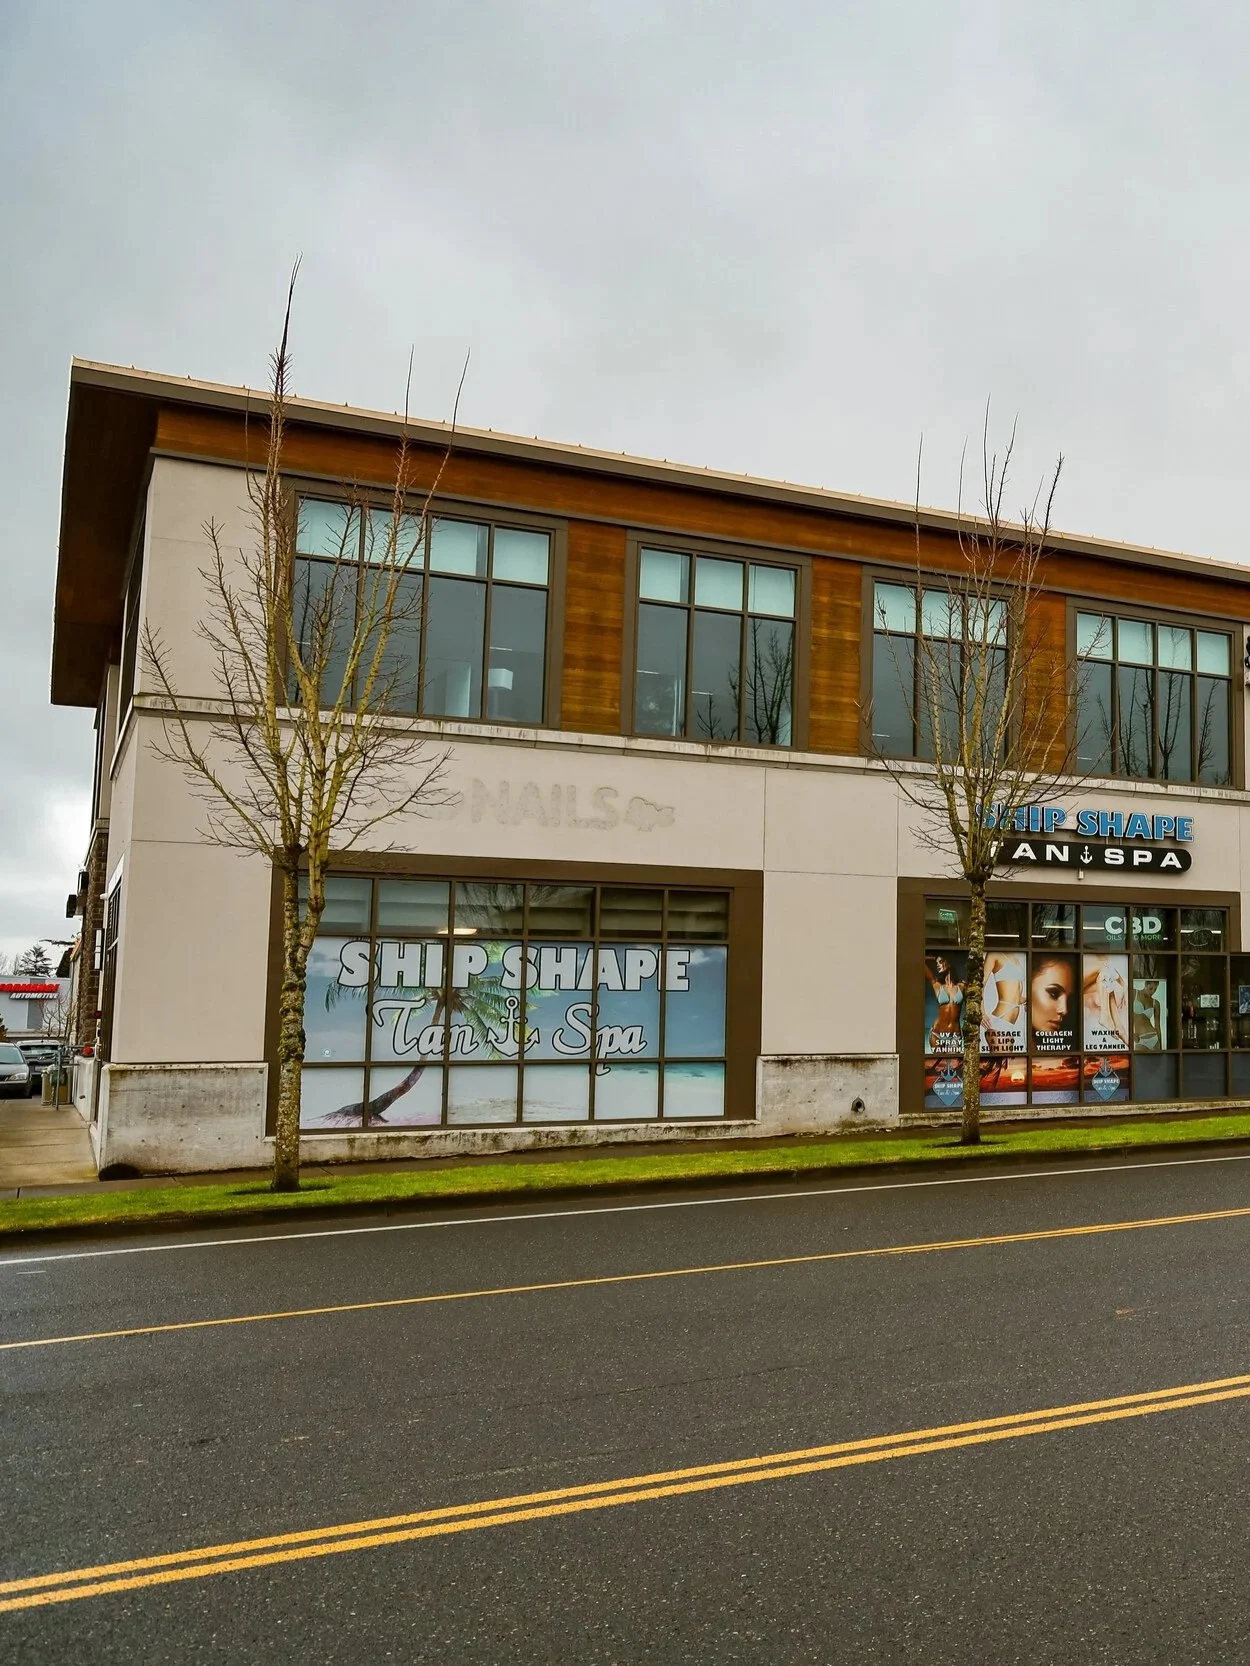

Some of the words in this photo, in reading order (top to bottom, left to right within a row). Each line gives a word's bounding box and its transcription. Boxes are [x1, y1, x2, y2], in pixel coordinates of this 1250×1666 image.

[470, 777, 620, 831] NAILS
[1077, 808, 1194, 842] SHAPE
[1104, 848, 1183, 869] SPA
[1104, 916, 1162, 935] CBD
[336, 940, 489, 989] SHIP
[500, 944, 692, 992] SHAPE
[366, 998, 480, 1056] Tan
[551, 1001, 648, 1077] Spa
[984, 1030, 1022, 1038] MASSAGE
